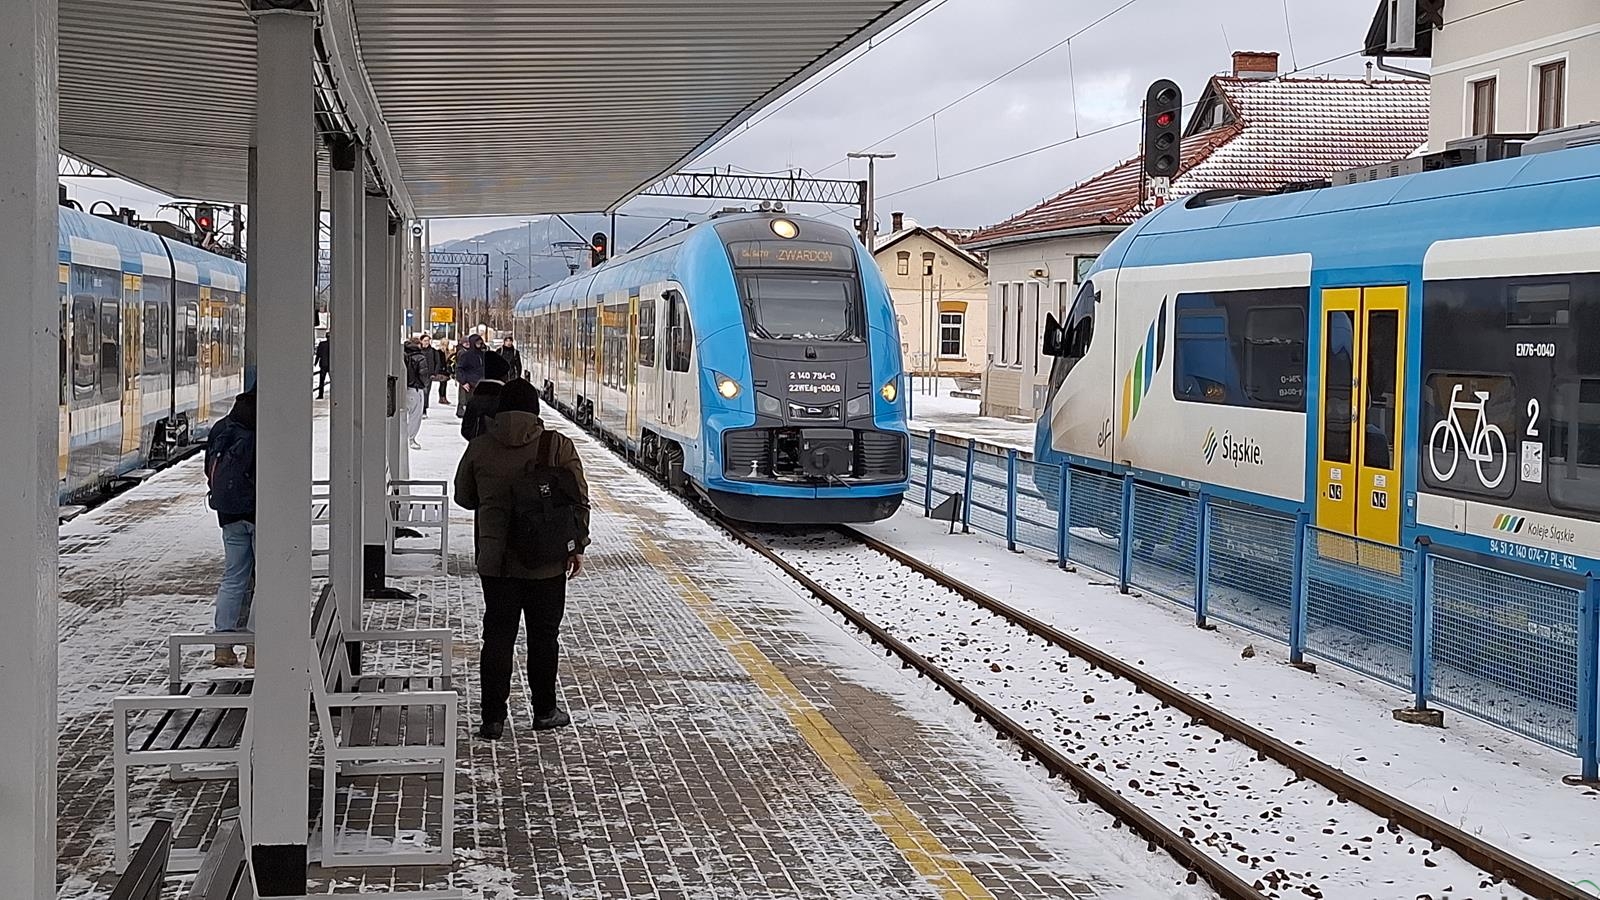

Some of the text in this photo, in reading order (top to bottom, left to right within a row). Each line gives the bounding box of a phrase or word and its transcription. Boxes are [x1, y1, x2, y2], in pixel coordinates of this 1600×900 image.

[1516, 343, 1555, 357] EN76-004D
[790, 371, 796, 380] 2
[797, 371, 811, 380] 140
[1526, 398, 1540, 437] 2
[1527, 522, 1575, 544] Koleje Śląskie
[1490, 540, 1578, 570] 94 51 2 140 074-7 PL-KSL
